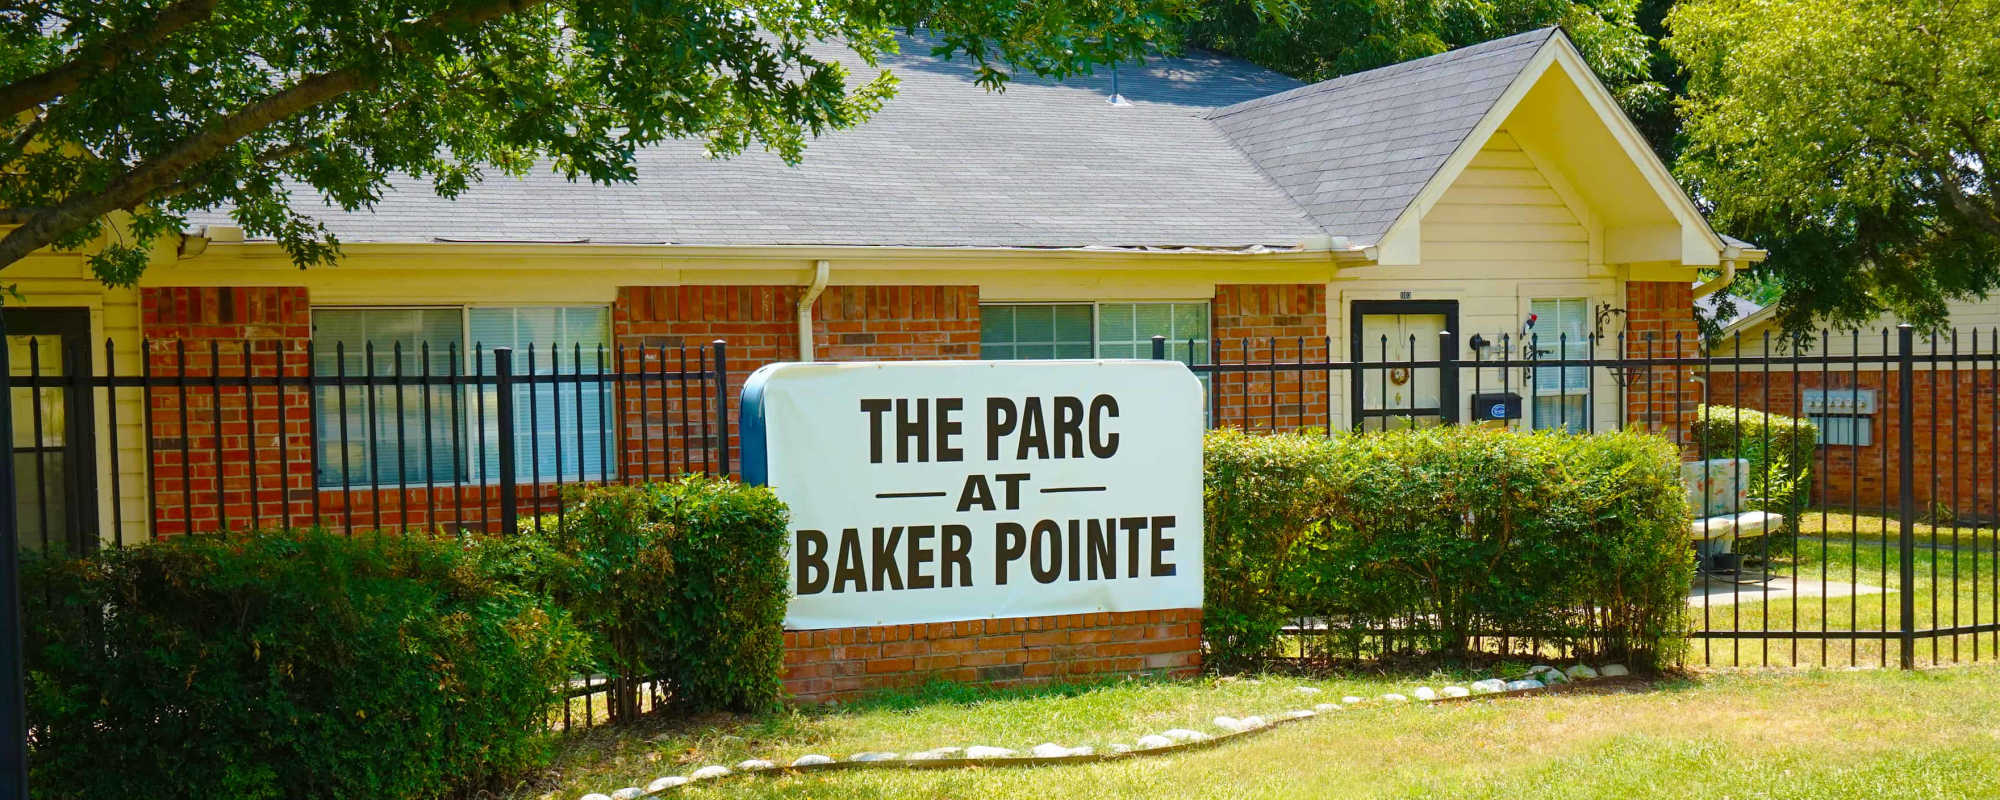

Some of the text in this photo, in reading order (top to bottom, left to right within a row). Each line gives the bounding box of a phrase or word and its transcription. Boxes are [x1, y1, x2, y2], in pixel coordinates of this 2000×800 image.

[860, 394, 1120, 464] THE PARC
[956, 473, 1031, 512] AT
[796, 515, 1177, 596] BAKER POINTE
